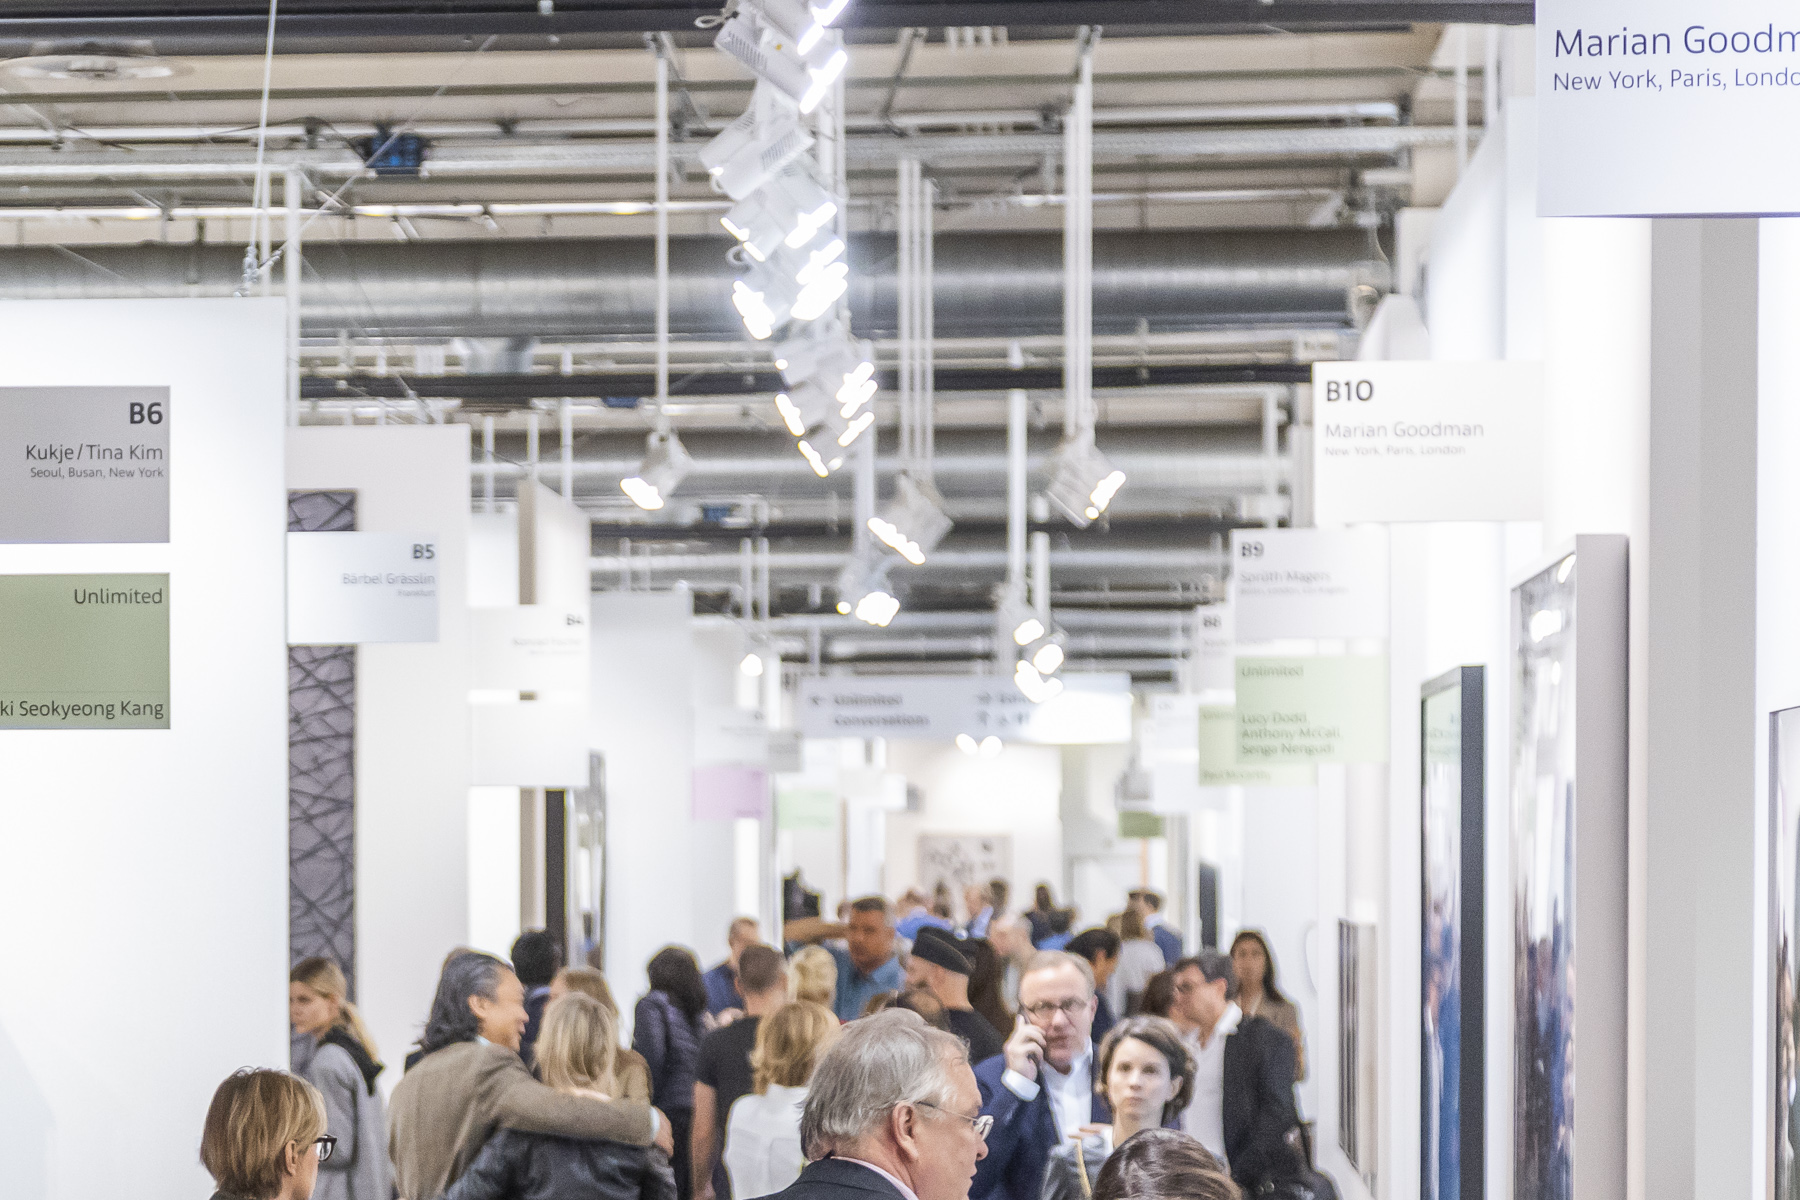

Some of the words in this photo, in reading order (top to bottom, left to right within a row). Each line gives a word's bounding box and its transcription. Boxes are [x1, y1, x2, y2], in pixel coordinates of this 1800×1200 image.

[1554, 26, 1671, 58] Marian
[1683, 23, 1800, 54] Goodm
[1553, 72, 1602, 91] New
[1608, 69, 1663, 92] York,
[1670, 68, 1727, 91] Paris,
[1734, 67, 1800, 87] Londo
[1325, 379, 1375, 402] B10
[129, 402, 164, 425] B6
[1325, 422, 1388, 439] Marian
[1393, 421, 1485, 438] Goodman
[129, 444, 163, 460] Kim
[1325, 446, 1349, 456] New
[1420, 444, 1466, 456] London
[30, 467, 65, 479] Seoul,
[68, 467, 106, 479] Busan,
[109, 467, 134, 478] New
[138, 467, 164, 478] York
[412, 543, 436, 560] B5
[1240, 541, 1266, 558] B9
[73, 587, 164, 605] Unlimited
[18, 700, 116, 721] Seokyeong
[120, 700, 165, 721] Kang
